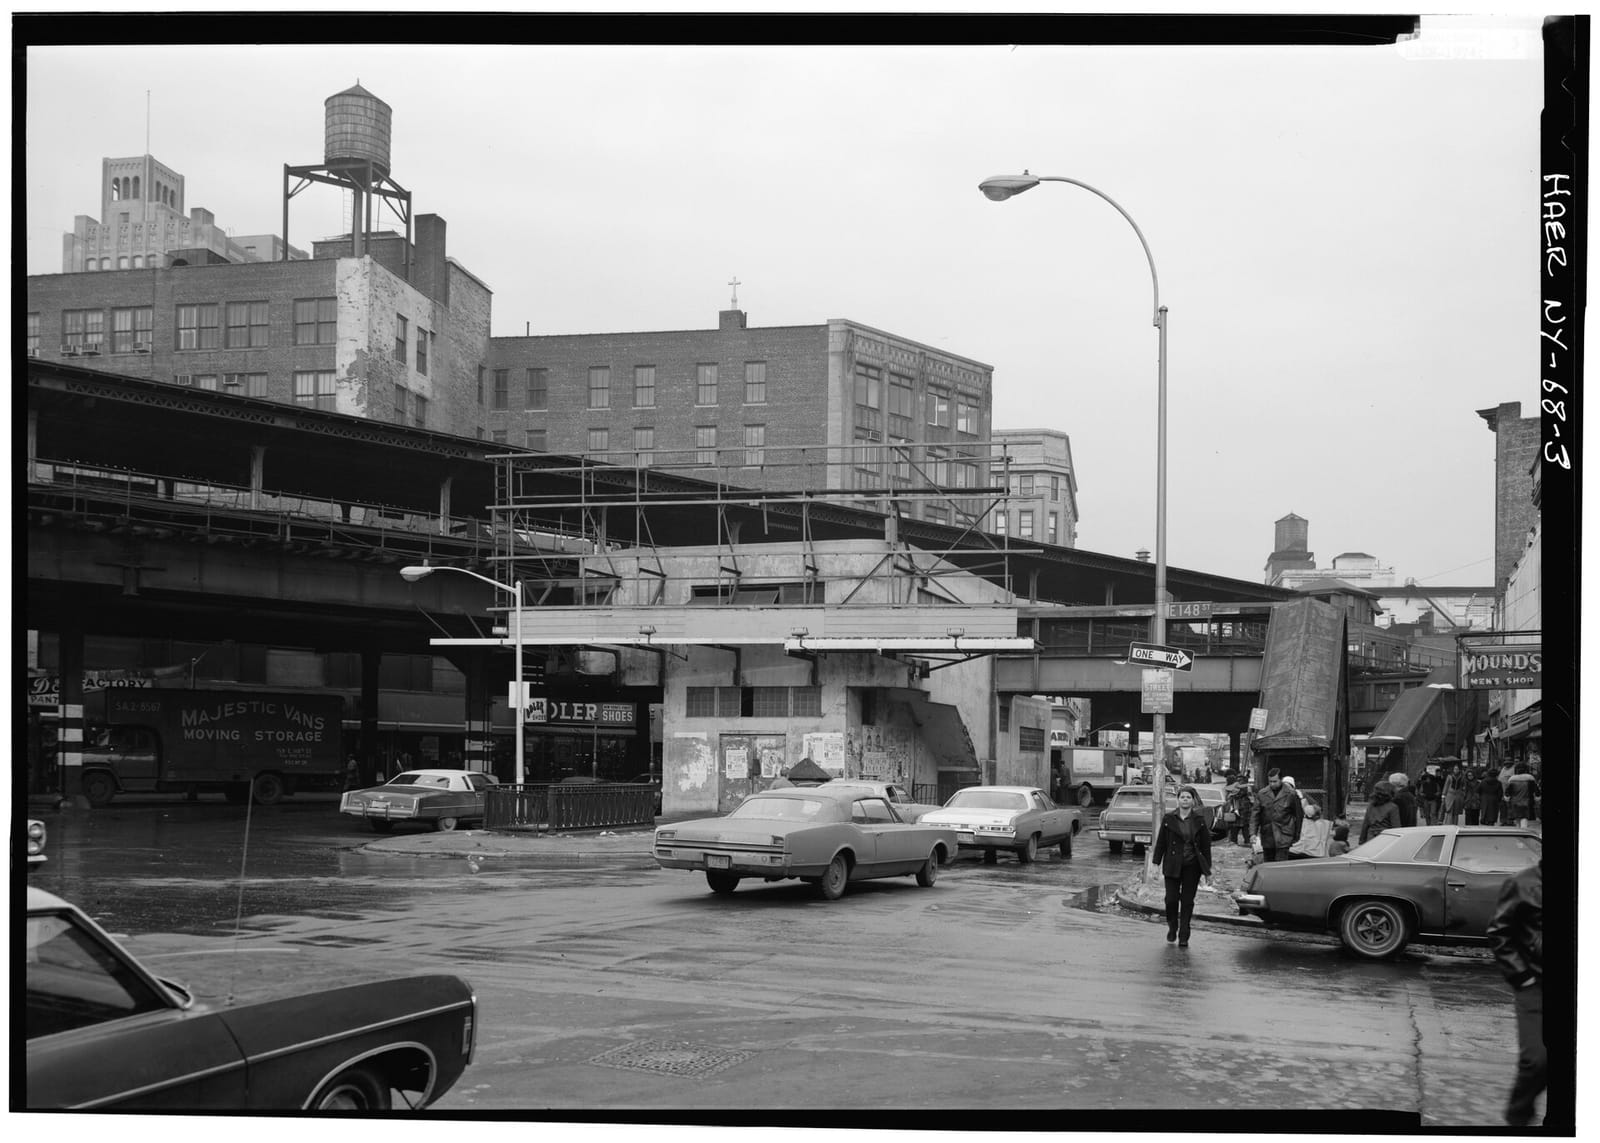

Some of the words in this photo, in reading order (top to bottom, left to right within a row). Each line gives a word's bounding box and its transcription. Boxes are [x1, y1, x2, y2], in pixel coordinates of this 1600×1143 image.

[1135, 649, 1154, 659] ONE
[1165, 652, 1185, 664] WAY
[1470, 677, 1500, 685] MEN'S
[1506, 677, 1534, 685] SHOP
[181, 700, 277, 728] MAJESTIC
[283, 703, 325, 731] VANS
[602, 711, 633, 722] SHOES
[184, 729, 241, 742] MOVING
[255, 730, 323, 743] STORAGE
